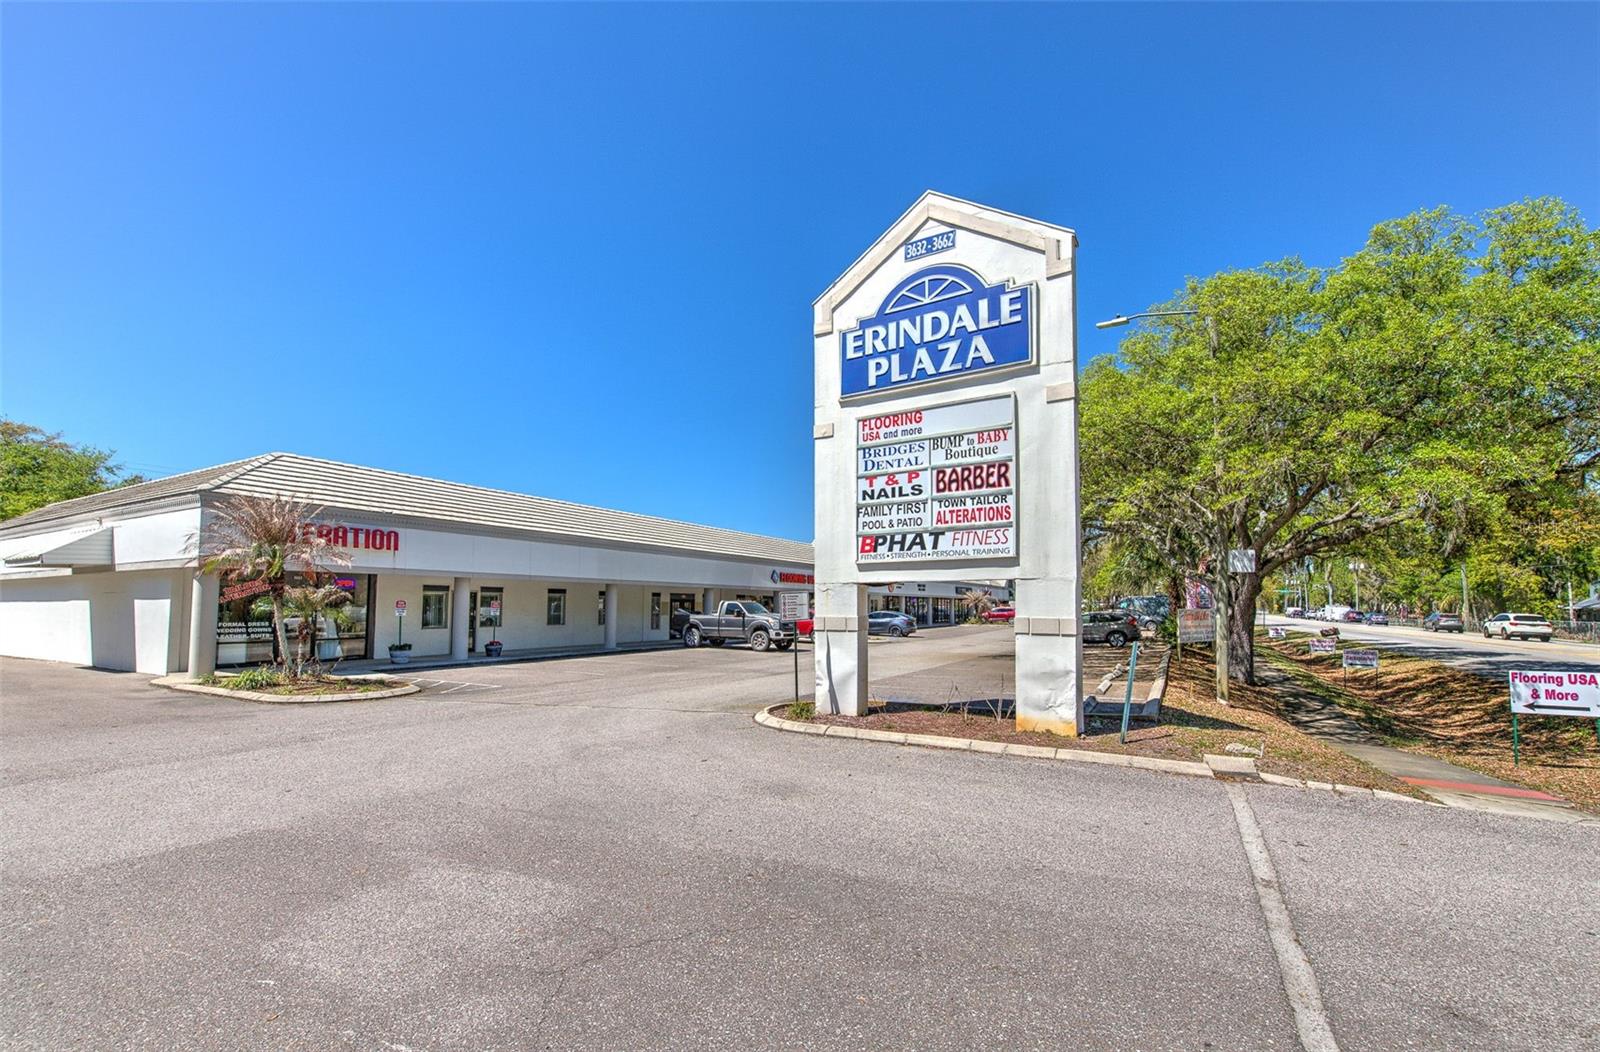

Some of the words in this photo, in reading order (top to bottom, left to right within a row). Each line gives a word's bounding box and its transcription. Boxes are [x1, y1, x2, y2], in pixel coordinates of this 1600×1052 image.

[846, 291, 1022, 360] ERINDALE
[868, 334, 995, 387] PLAZA
[862, 411, 922, 432] FLOORING
[862, 431, 881, 442] USA
[883, 429, 898, 439] and
[901, 426, 922, 437] more
[932, 435, 964, 450] BUMP
[966, 437, 974, 445] to
[977, 429, 1009, 444] BABY
[862, 442, 925, 459] BRIDGES
[945, 444, 998, 461] Boutique
[864, 456, 923, 471] DENTAL
[865, 476, 877, 487] T
[885, 474, 899, 486] &
[908, 471, 920, 483] P
[936, 462, 1010, 493] BARBER
[862, 484, 923, 500] NAILS
[857, 505, 893, 518] FAMILY
[897, 502, 928, 514] FIRST
[938, 499, 966, 509] TOWN
[970, 495, 1008, 505] TAILOR
[935, 505, 1011, 525] ALTERATIONS
[862, 520, 886, 530] POOL
[888, 519, 894, 528] &
[897, 517, 923, 527] PATIO
[860, 531, 945, 553] BPHAT
[951, 528, 1010, 546] FITNESS
[932, 548, 970, 557] PERSONAL
[972, 546, 1010, 555] TRAINING
[1511, 672, 1563, 687] Flooring
[1568, 673, 1598, 686] USA
[1531, 688, 1540, 699] &
[1545, 689, 1579, 701] More
